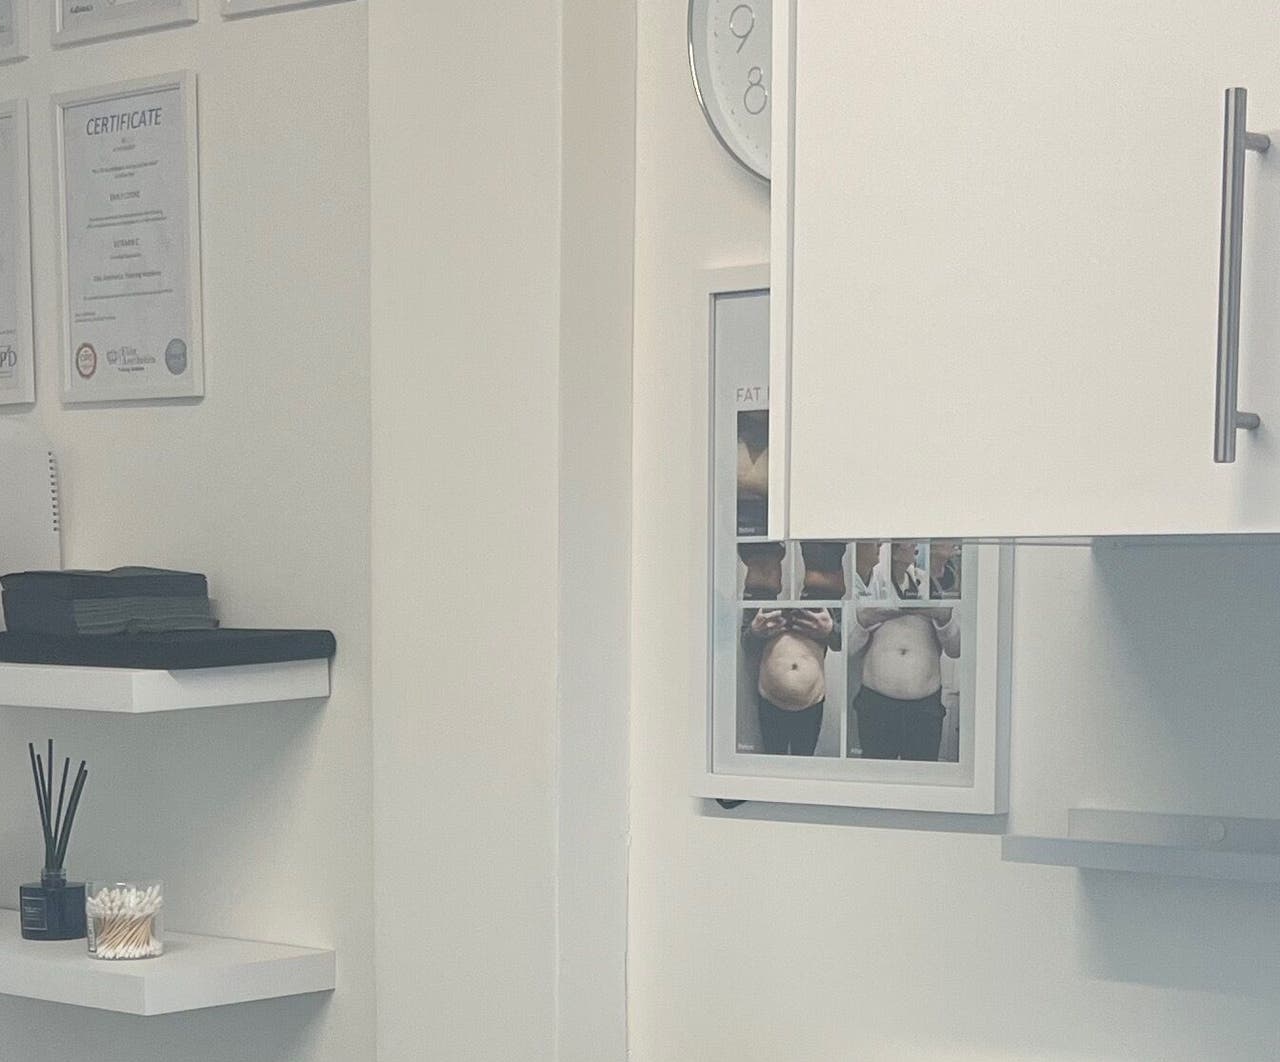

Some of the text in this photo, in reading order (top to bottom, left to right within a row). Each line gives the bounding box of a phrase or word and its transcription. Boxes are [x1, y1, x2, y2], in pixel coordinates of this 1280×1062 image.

[729, 4, 755, 54] 9
[743, 66, 768, 115] 8
[86, 107, 162, 136] CERTIFICATE
[736, 386, 761, 402] FAT
